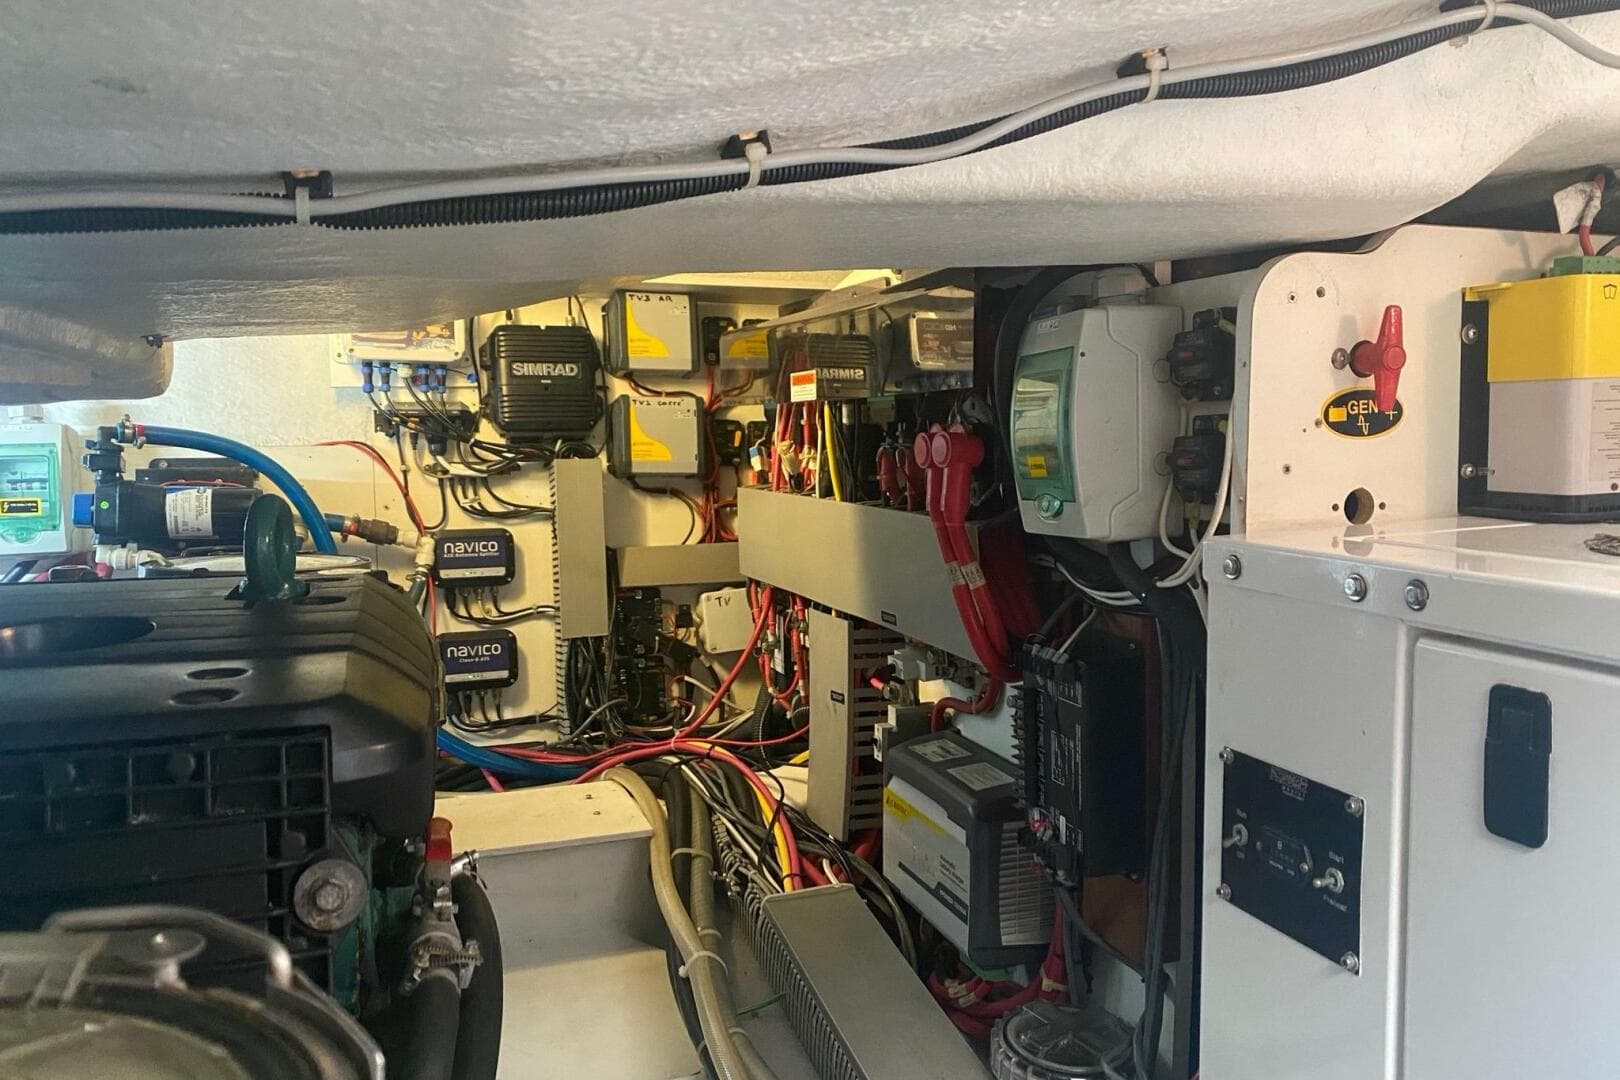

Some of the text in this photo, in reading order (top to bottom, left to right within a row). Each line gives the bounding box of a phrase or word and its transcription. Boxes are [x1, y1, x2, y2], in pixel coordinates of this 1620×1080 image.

[628, 294, 651, 302] TV3
[512, 362, 578, 376] SIMRAD
[1347, 400, 1379, 414] GEN
[444, 541, 498, 553] navico
[715, 596, 731, 607] TV
[447, 643, 502, 658] navico
